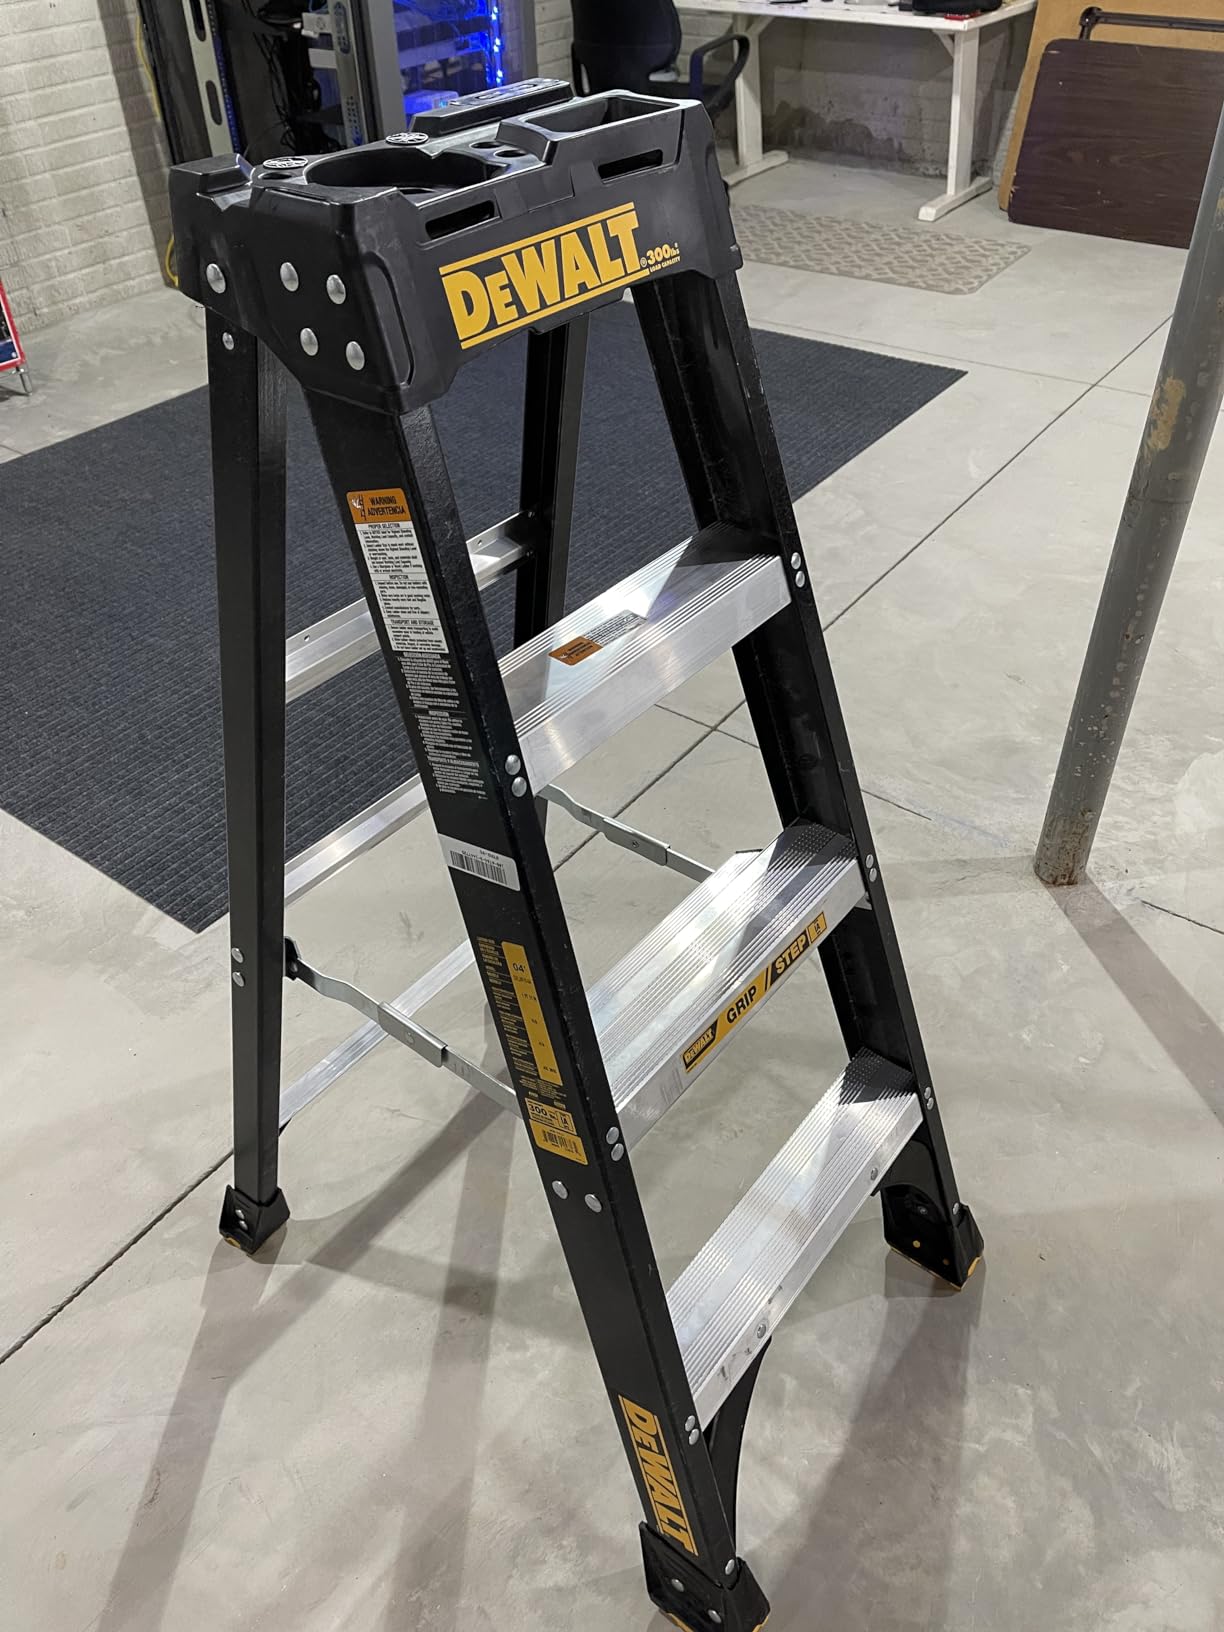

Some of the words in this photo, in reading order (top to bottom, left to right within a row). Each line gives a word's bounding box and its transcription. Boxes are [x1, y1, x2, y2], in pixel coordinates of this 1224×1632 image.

[369, 496, 397, 505] WARNING
[726, 985, 757, 1024] GRIP
[775, 934, 807, 974] STEP
[528, 1103, 548, 1117] 300
